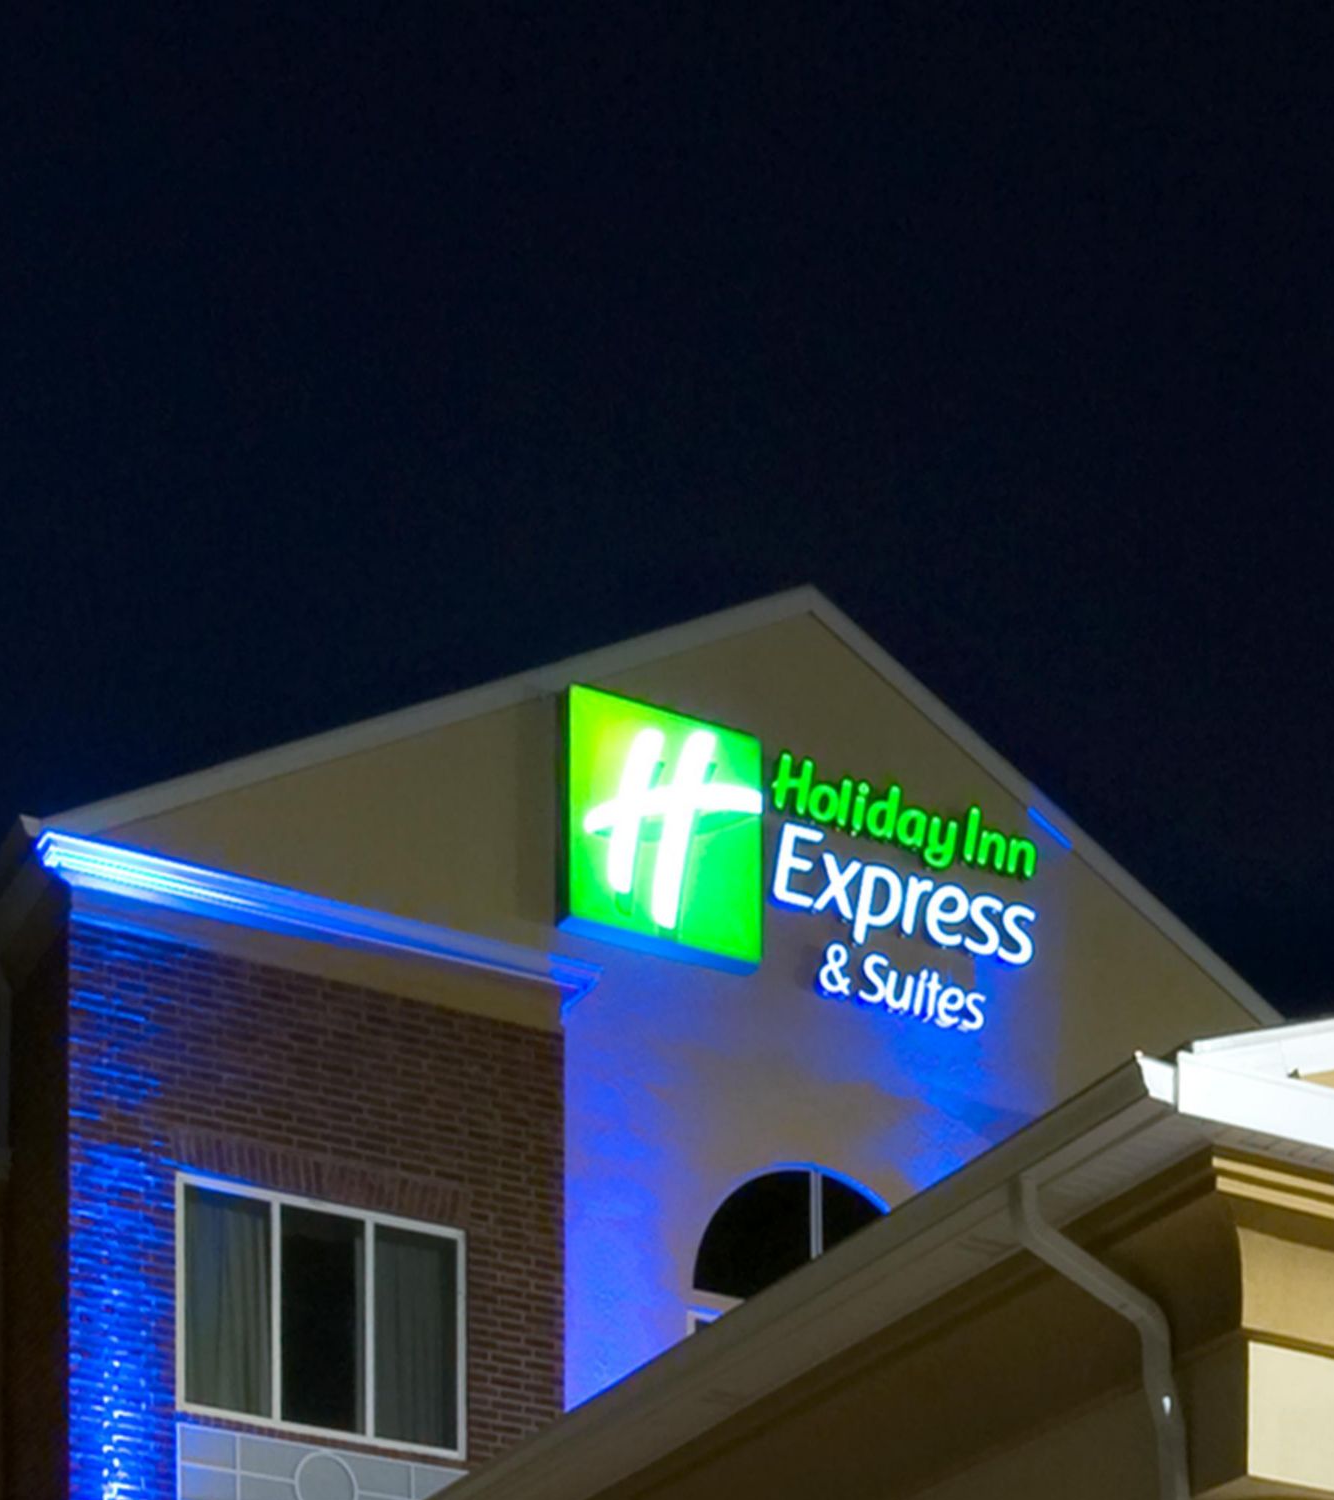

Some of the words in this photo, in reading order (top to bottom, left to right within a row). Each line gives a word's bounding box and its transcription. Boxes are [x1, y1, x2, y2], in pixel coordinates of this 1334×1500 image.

[772, 753, 958, 868] Holiday
[965, 807, 1038, 877] Inn
[772, 823, 1037, 965] Express
[819, 943, 851, 995] &
[859, 954, 986, 1031] Suites
